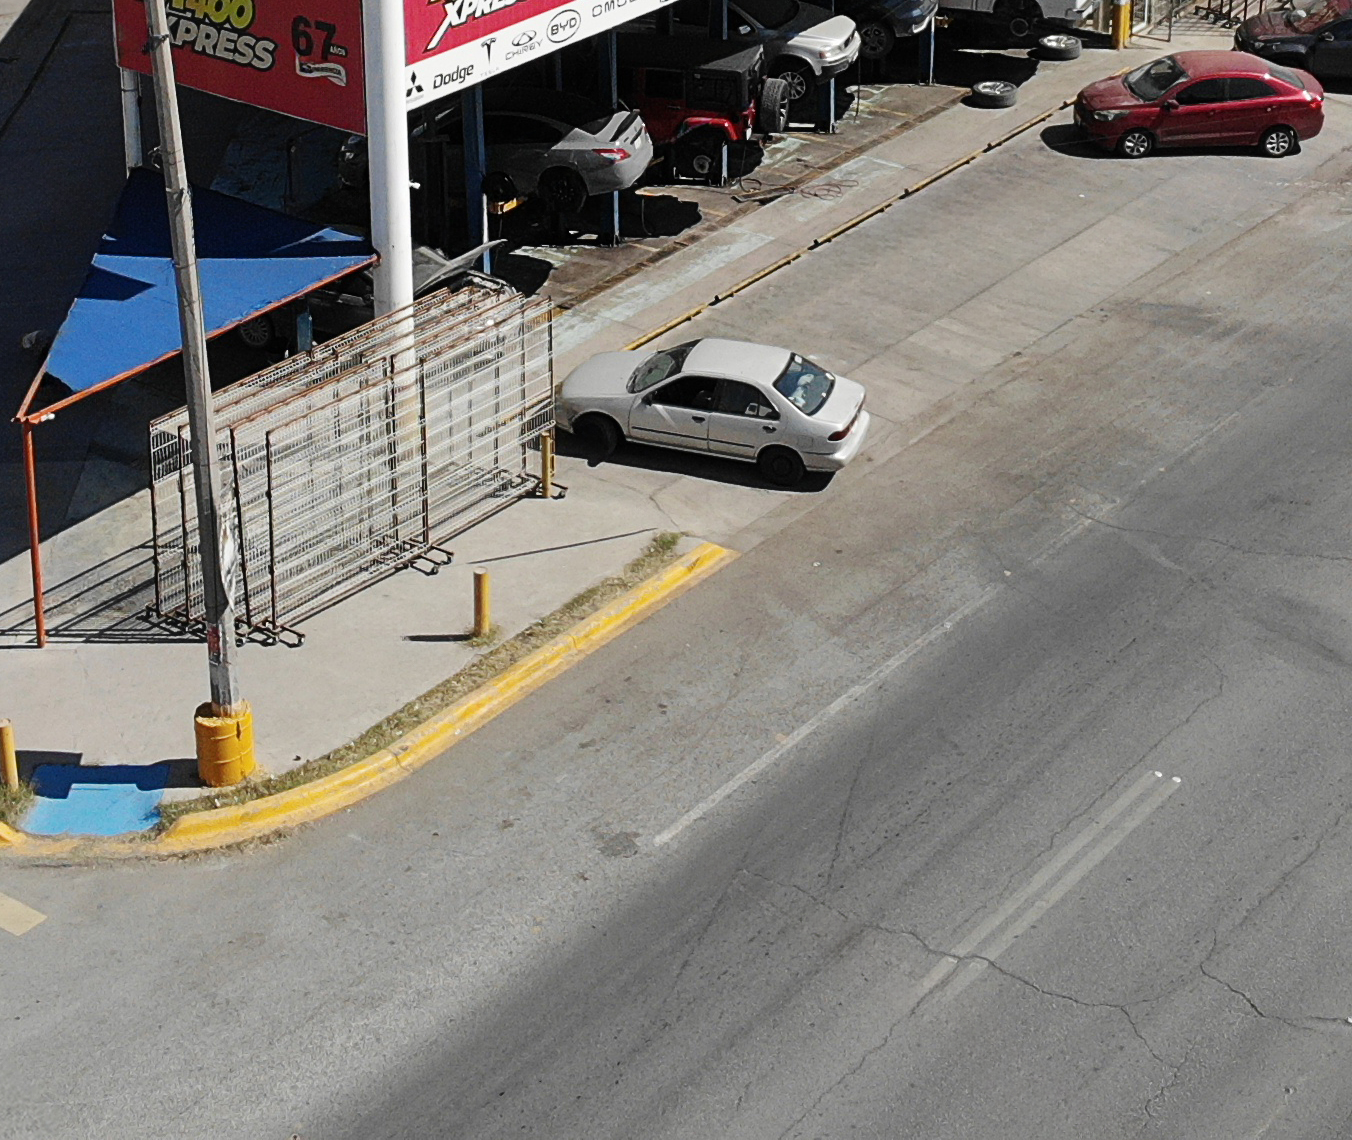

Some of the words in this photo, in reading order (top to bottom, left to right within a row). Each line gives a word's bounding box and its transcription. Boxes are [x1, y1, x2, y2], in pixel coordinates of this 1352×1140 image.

[292, 15, 337, 60] 67
[550, 17, 577, 36] BYD
[433, 63, 474, 90] Dodge
